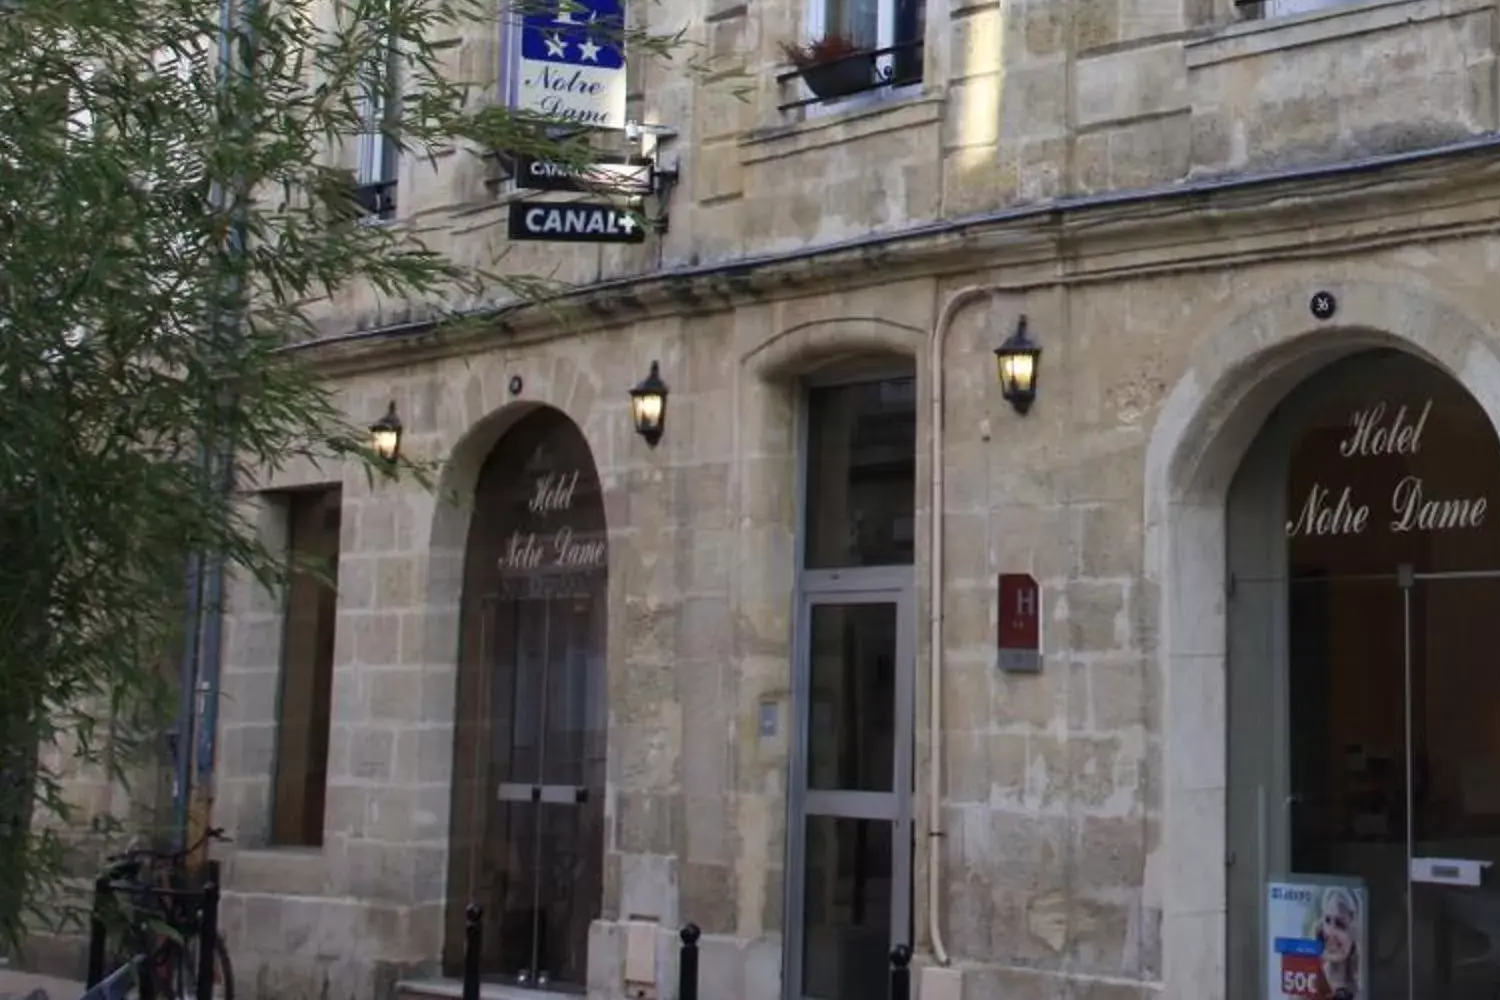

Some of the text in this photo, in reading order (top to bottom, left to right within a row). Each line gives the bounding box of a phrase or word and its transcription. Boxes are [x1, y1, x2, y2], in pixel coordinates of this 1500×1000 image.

[525, 66, 601, 95] Notre
[536, 95, 610, 123] Dame
[525, 209, 636, 234] CANAL+
[1339, 398, 1433, 457] Hotel
[1285, 475, 1487, 536] Notre Dame
[1017, 588, 1035, 616] H
